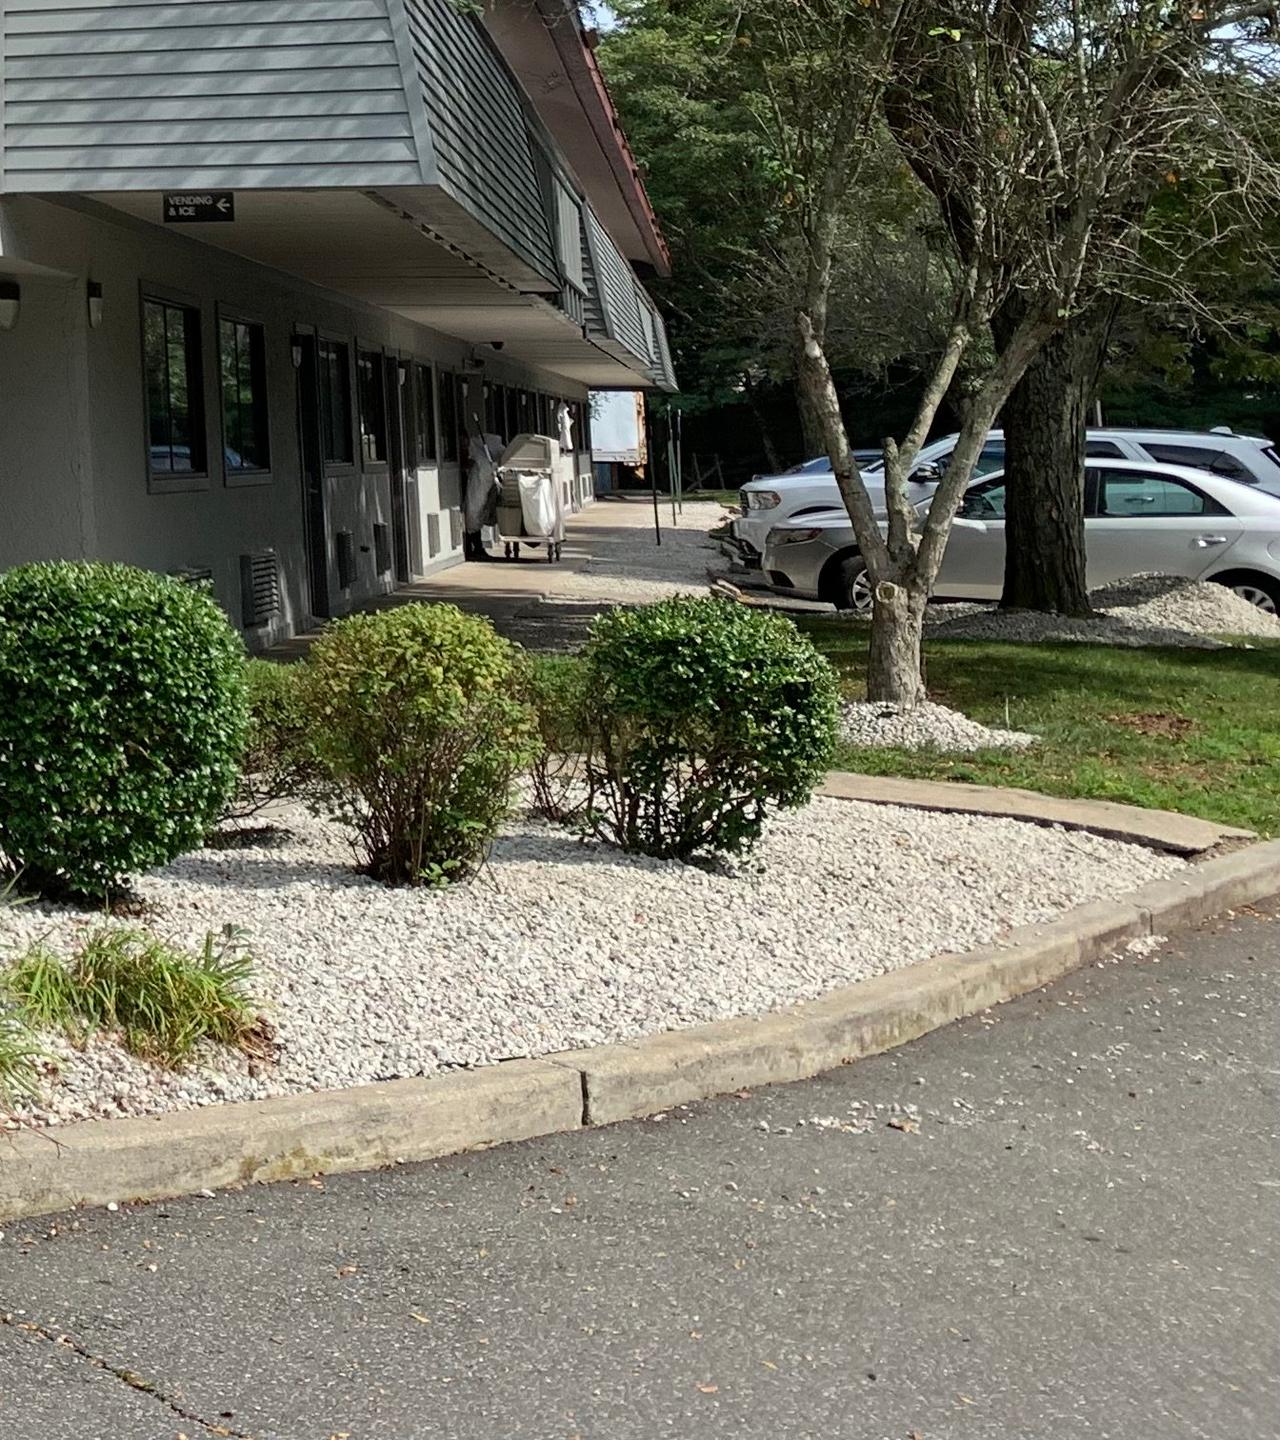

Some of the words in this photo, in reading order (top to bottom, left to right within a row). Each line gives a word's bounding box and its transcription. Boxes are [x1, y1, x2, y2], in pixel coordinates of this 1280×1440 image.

[168, 195, 214, 206] VENDING
[168, 207, 177, 217] &
[178, 206, 196, 216] ICE
